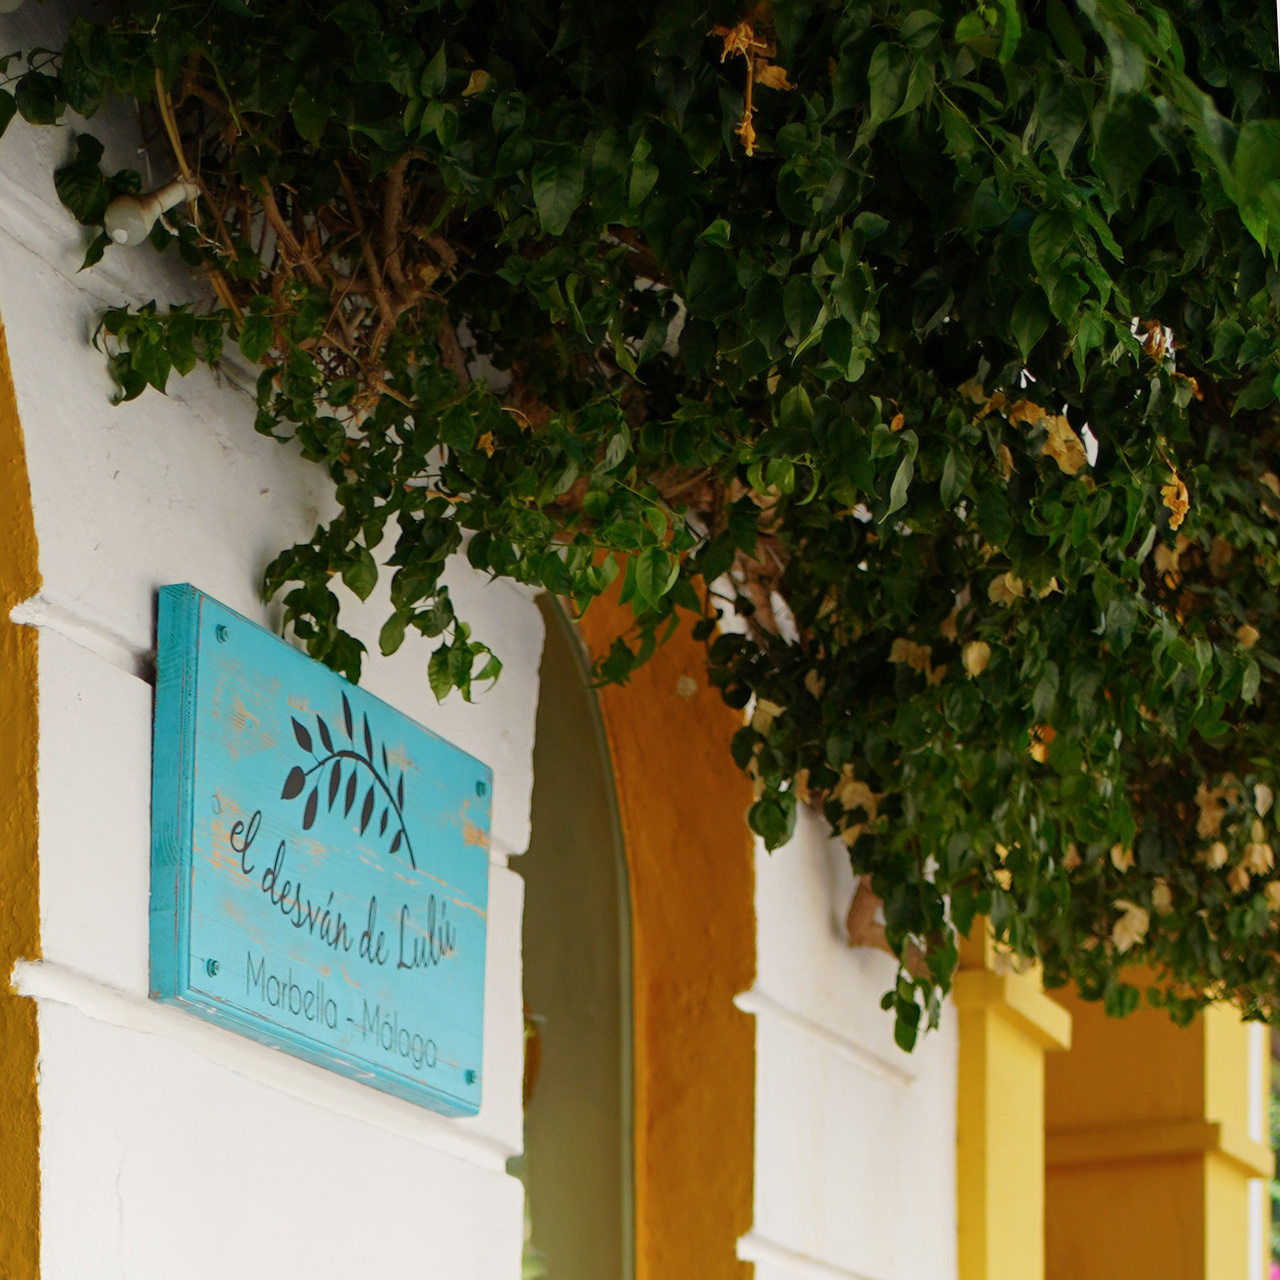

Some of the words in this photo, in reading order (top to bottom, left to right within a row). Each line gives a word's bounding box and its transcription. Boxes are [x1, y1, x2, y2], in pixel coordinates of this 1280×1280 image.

[230, 809, 263, 875] el
[261, 839, 354, 953] desván
[358, 894, 391, 966] de
[396, 893, 458, 970] Lulú
[245, 949, 339, 1031] Marbella
[361, 997, 439, 1071] Málaga
